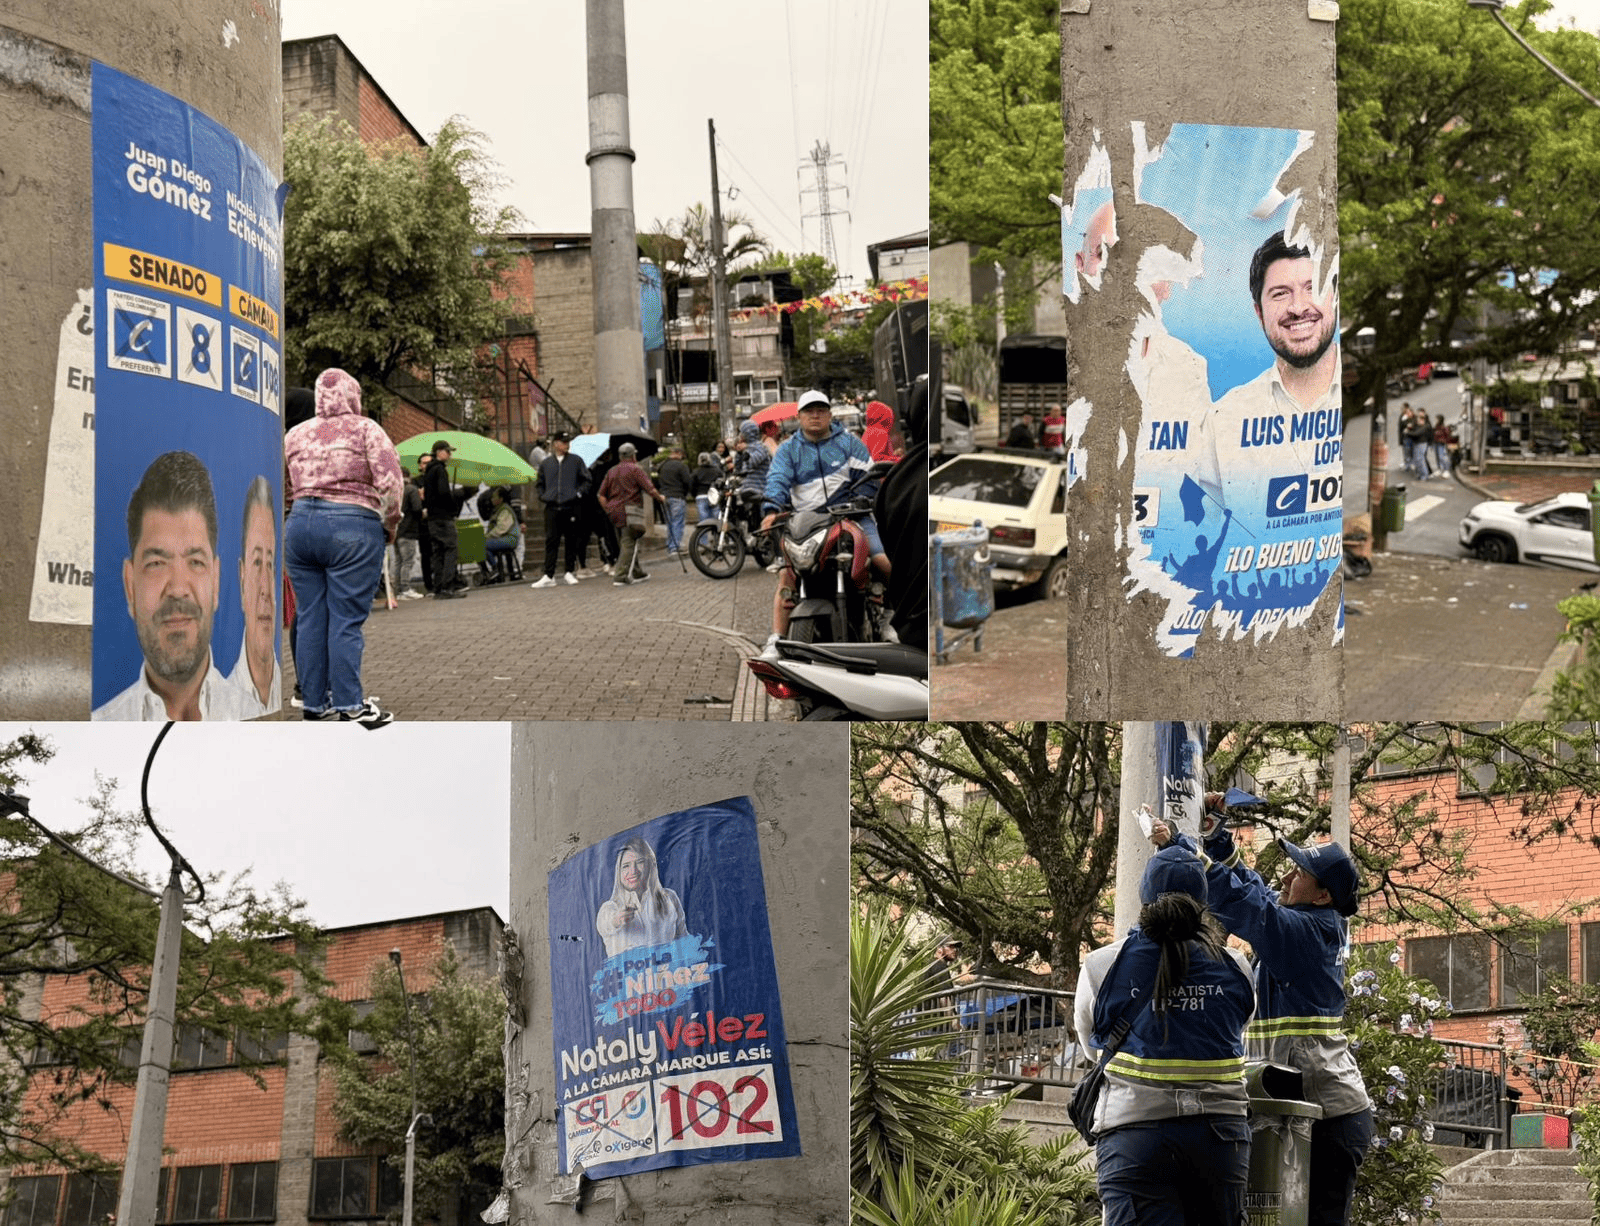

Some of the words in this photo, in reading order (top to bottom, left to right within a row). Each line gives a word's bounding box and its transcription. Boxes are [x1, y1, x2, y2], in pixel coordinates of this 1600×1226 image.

[124, 142, 167, 173] Juan
[171, 160, 212, 194] Diego
[126, 162, 212, 222] Gómez
[129, 253, 207, 296] SENADO
[120, 360, 162, 375] PREFERENTE
[191, 322, 211, 374] 8
[1240, 414, 1285, 448] LUIS
[1289, 407, 1342, 443] MIGU
[1314, 434, 1342, 467] LÓP
[1266, 520, 1272, 530] A
[1272, 518, 1281, 529] LA
[1282, 515, 1309, 528] CÁMARA
[1310, 512, 1323, 524] POR
[1255, 537, 1316, 571] BUENO
[625, 961, 711, 999] Niñez
[560, 1026, 659, 1081] Nataly
[655, 1009, 768, 1051] Vélez
[563, 1087, 572, 1100] A
[574, 1082, 588, 1098] LA
[591, 1062, 652, 1091] CÁMARA
[656, 1050, 731, 1075] MARQUE
[735, 1043, 772, 1063] ASÍ:
[660, 1075, 775, 1141] 102
